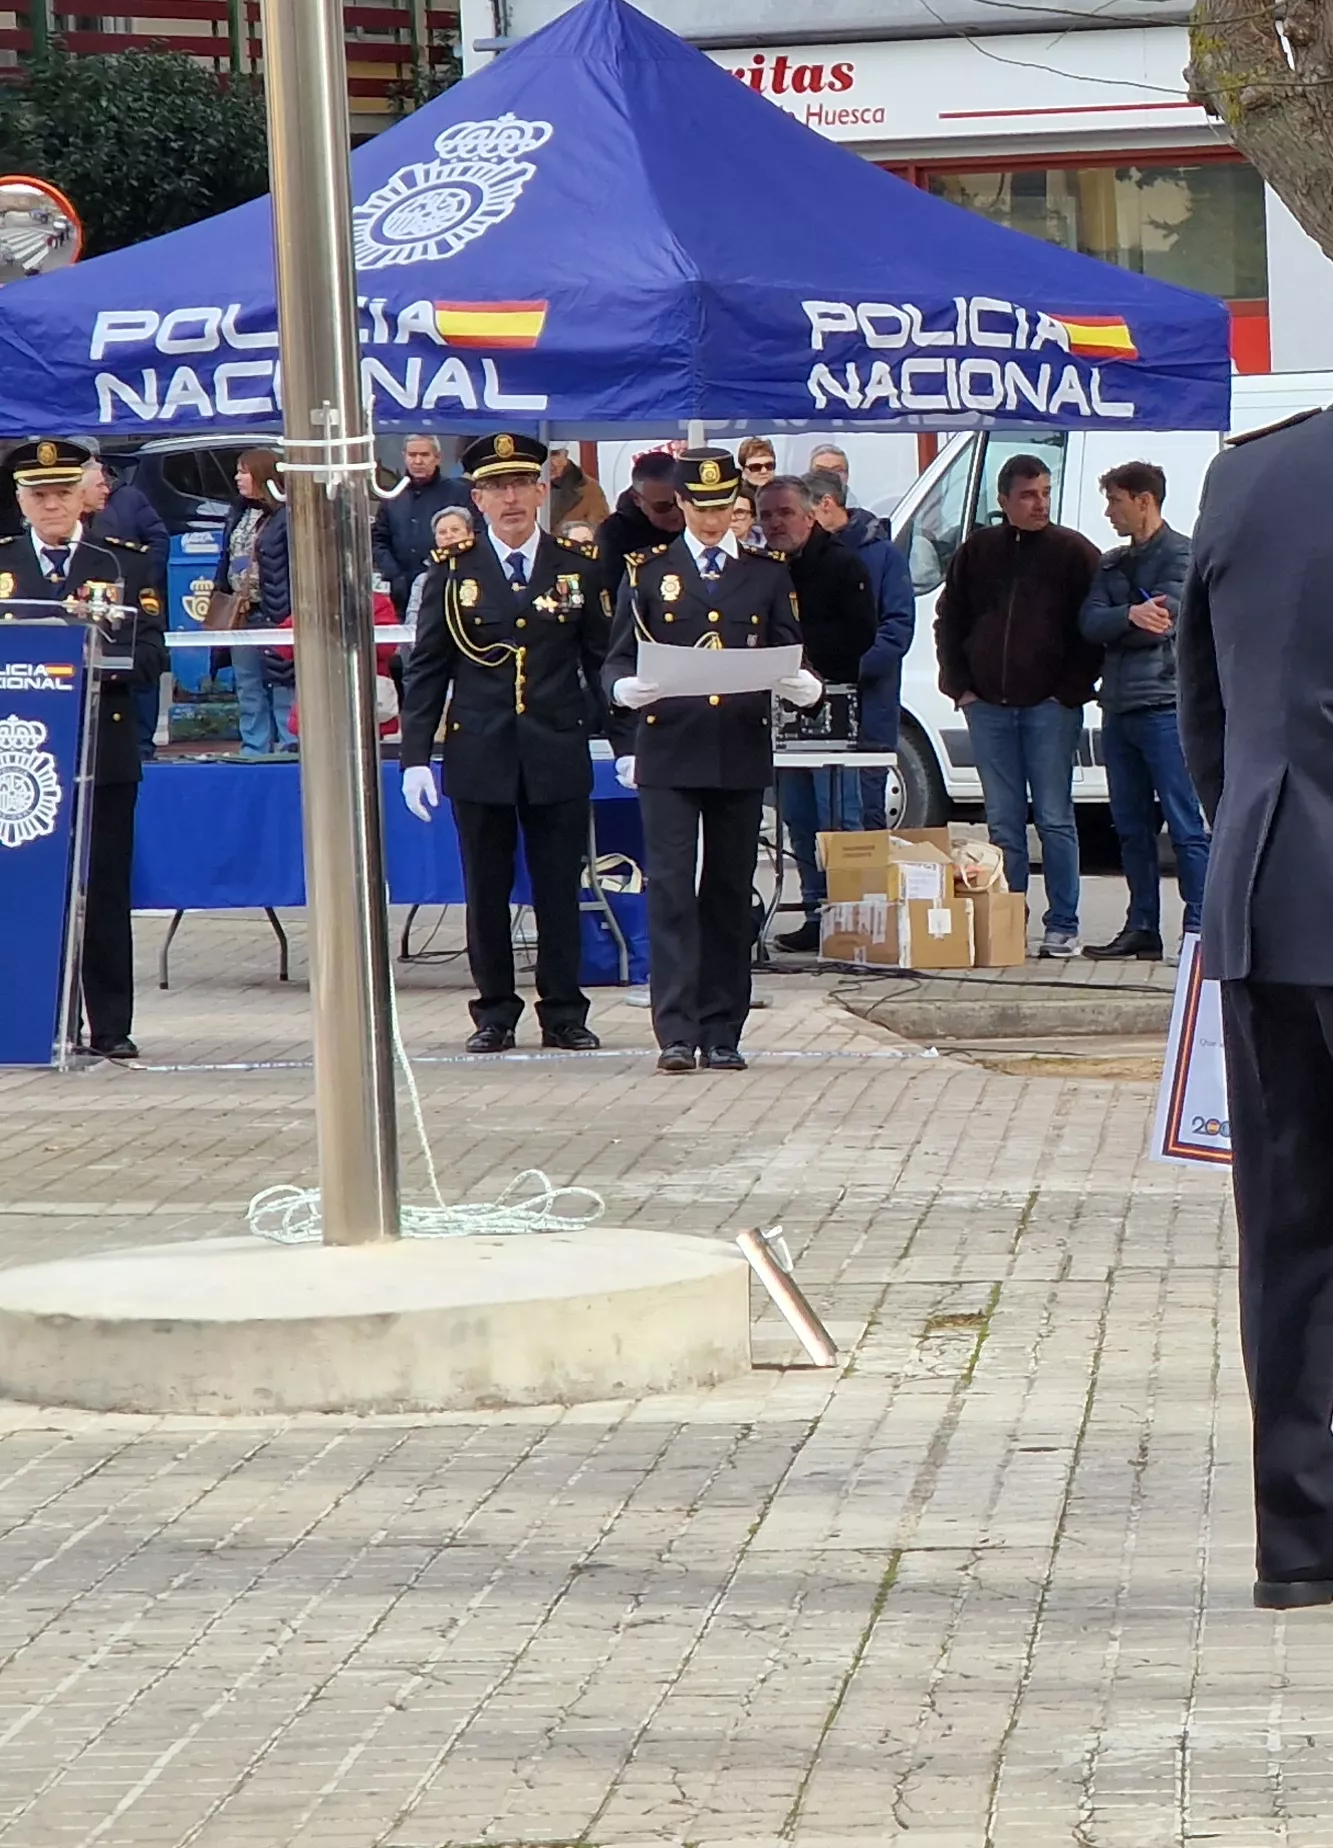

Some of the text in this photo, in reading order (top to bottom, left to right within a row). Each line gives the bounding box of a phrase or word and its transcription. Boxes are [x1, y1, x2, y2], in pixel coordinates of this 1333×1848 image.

[806, 103, 885, 126] Huesca
[94, 357, 548, 423] NACNAL
[806, 358, 1134, 418] NACIONAL
[0, 677, 73, 690] IONAL
